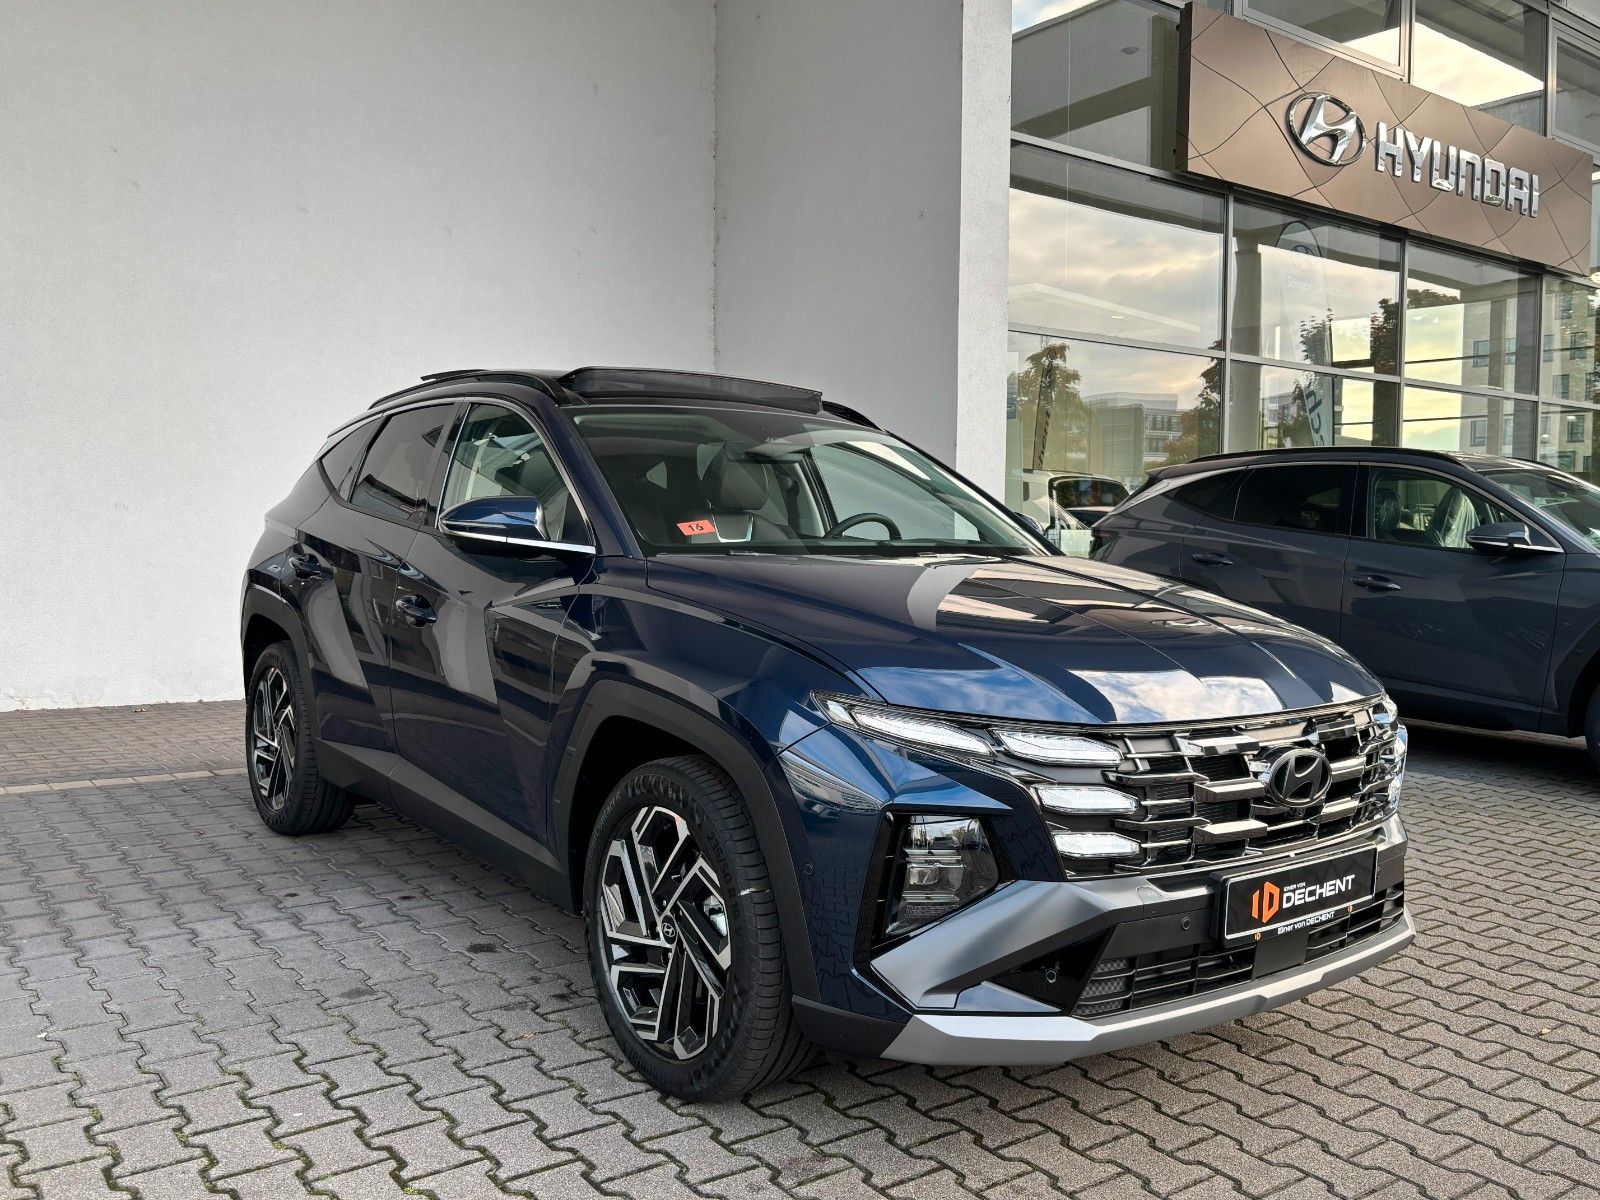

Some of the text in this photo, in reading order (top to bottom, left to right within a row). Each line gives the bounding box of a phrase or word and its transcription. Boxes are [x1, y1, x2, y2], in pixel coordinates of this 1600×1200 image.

[1375, 121, 1540, 218] HYUNDAI
[688, 523, 704, 532] 16
[1282, 874, 1355, 909] DECHENT
[1277, 911, 1336, 935] Einer von DECHENT
